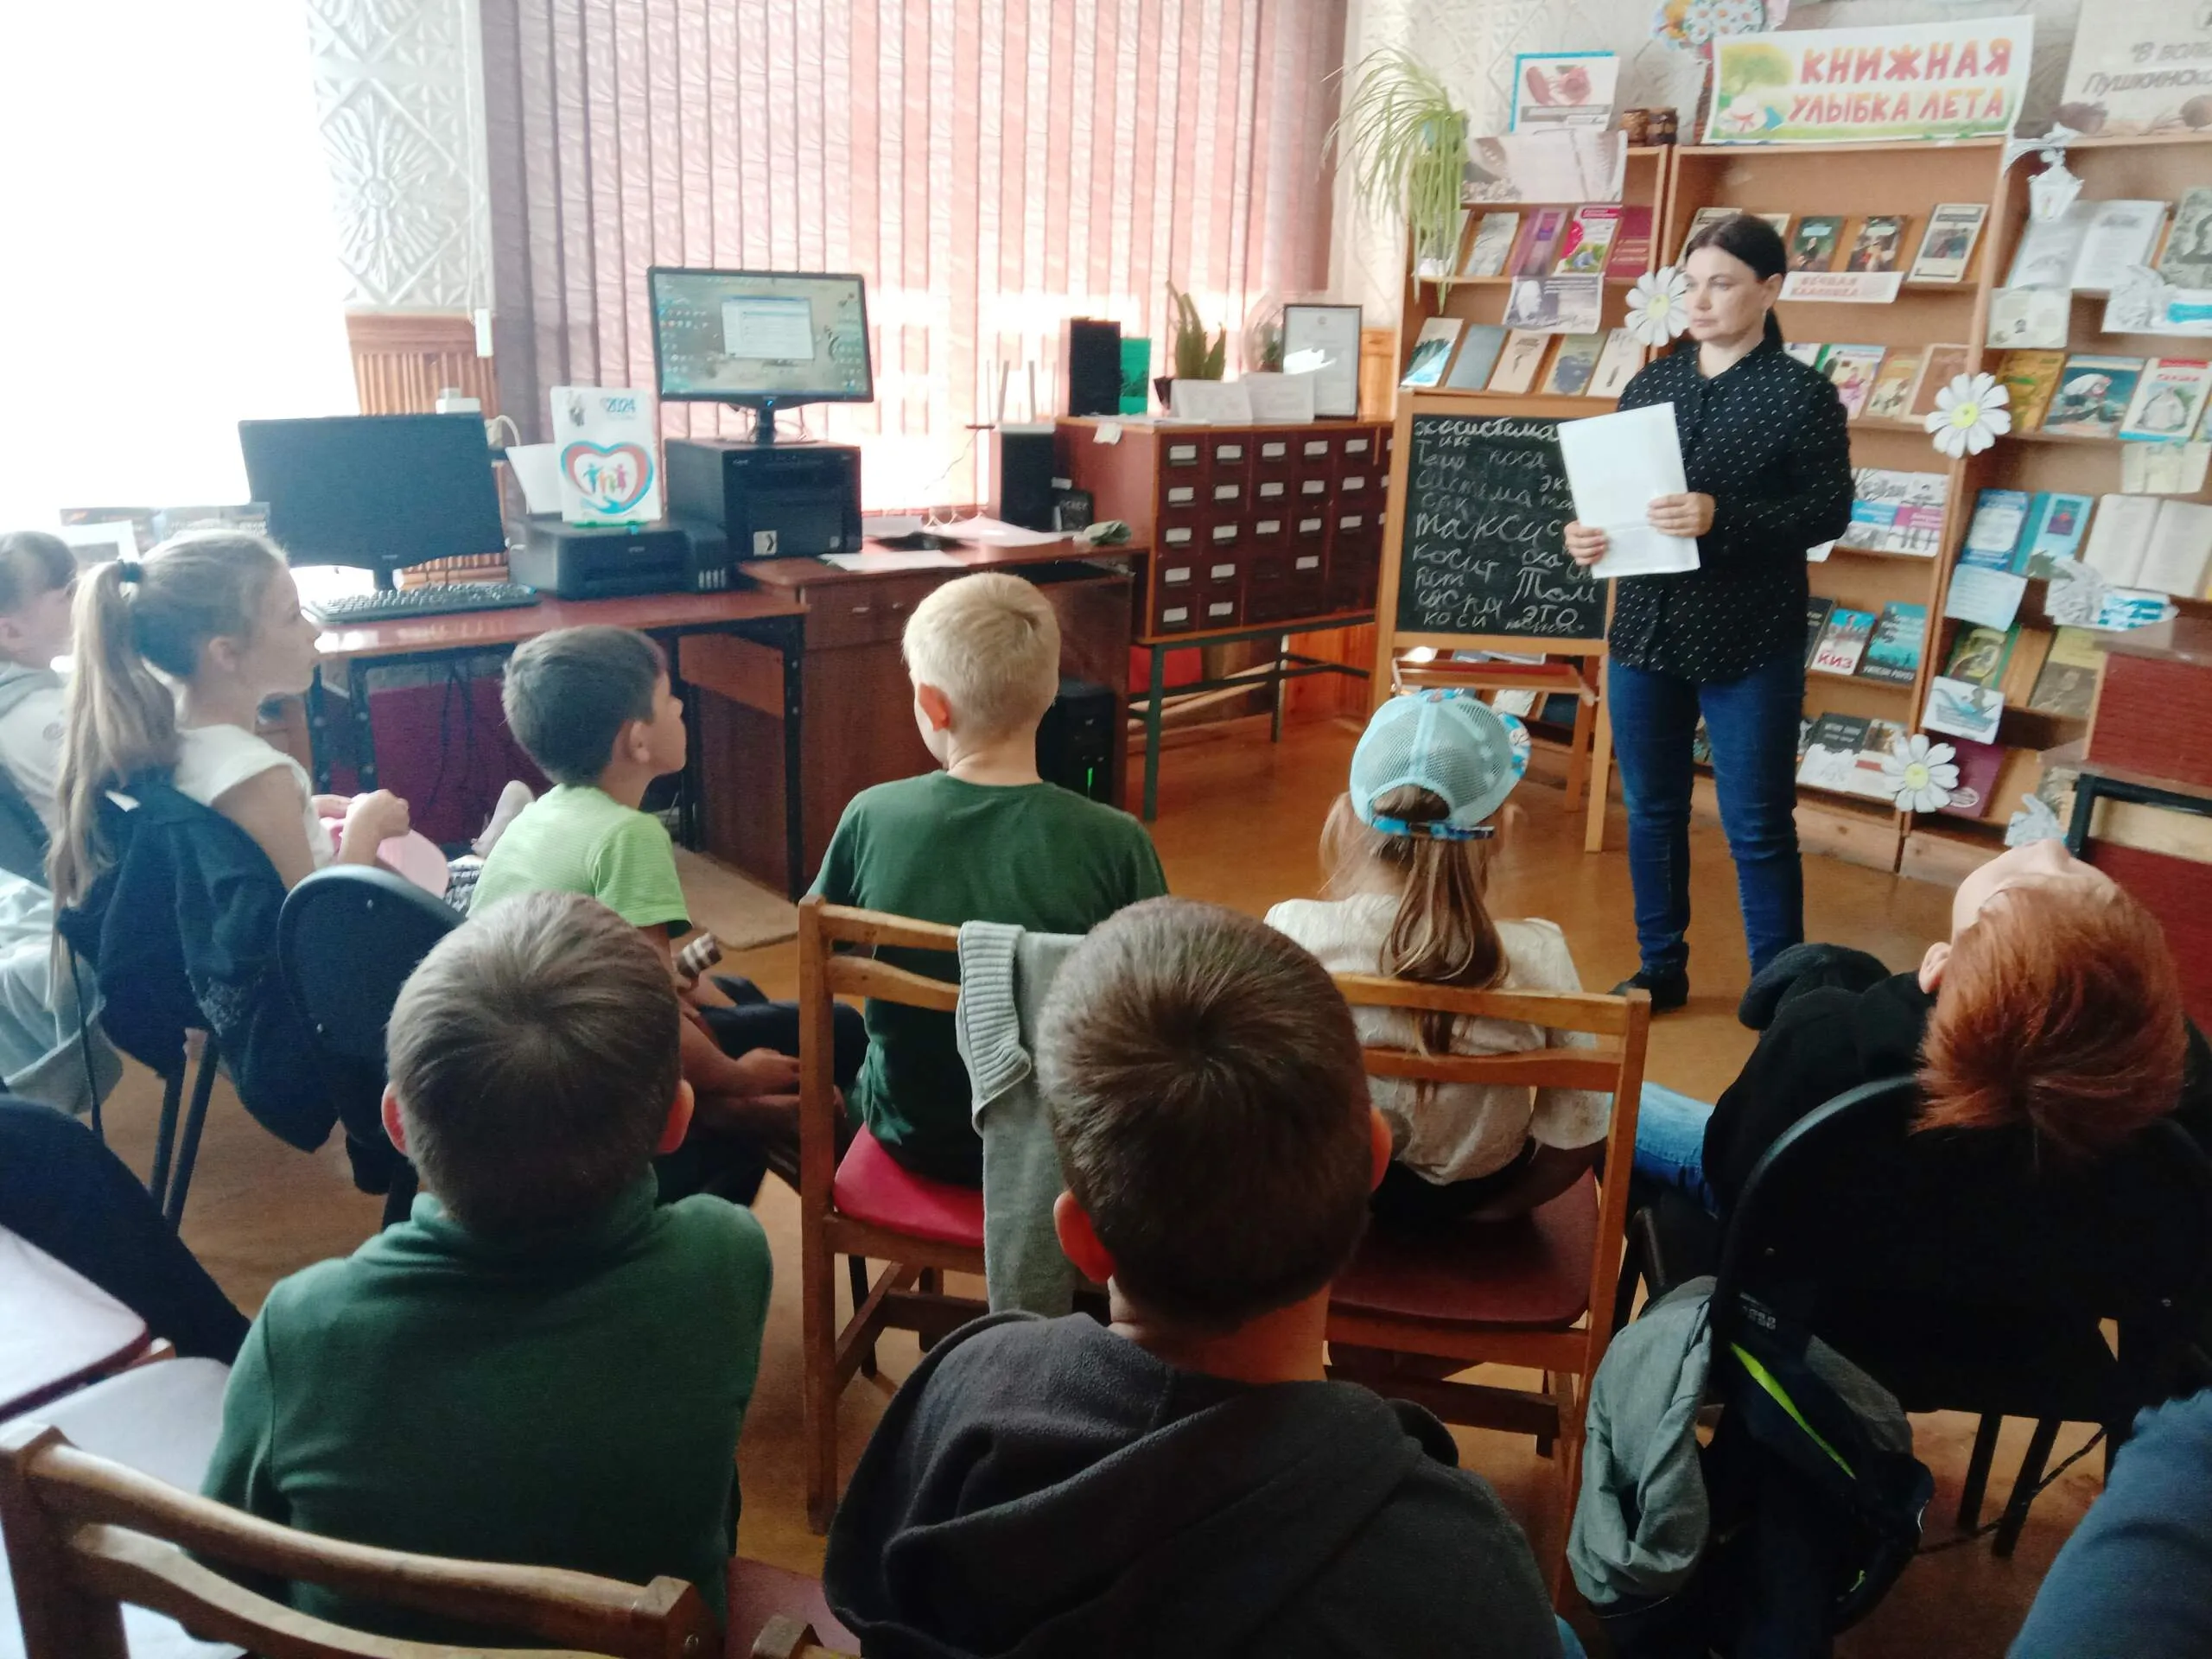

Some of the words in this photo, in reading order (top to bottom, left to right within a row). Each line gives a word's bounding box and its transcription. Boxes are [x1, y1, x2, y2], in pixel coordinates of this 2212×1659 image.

[1801, 38, 2013, 85] КНИЖНАЯ
[1788, 92, 1910, 124] УЛЫБКА
[1918, 87, 2005, 119] ЛЕТА
